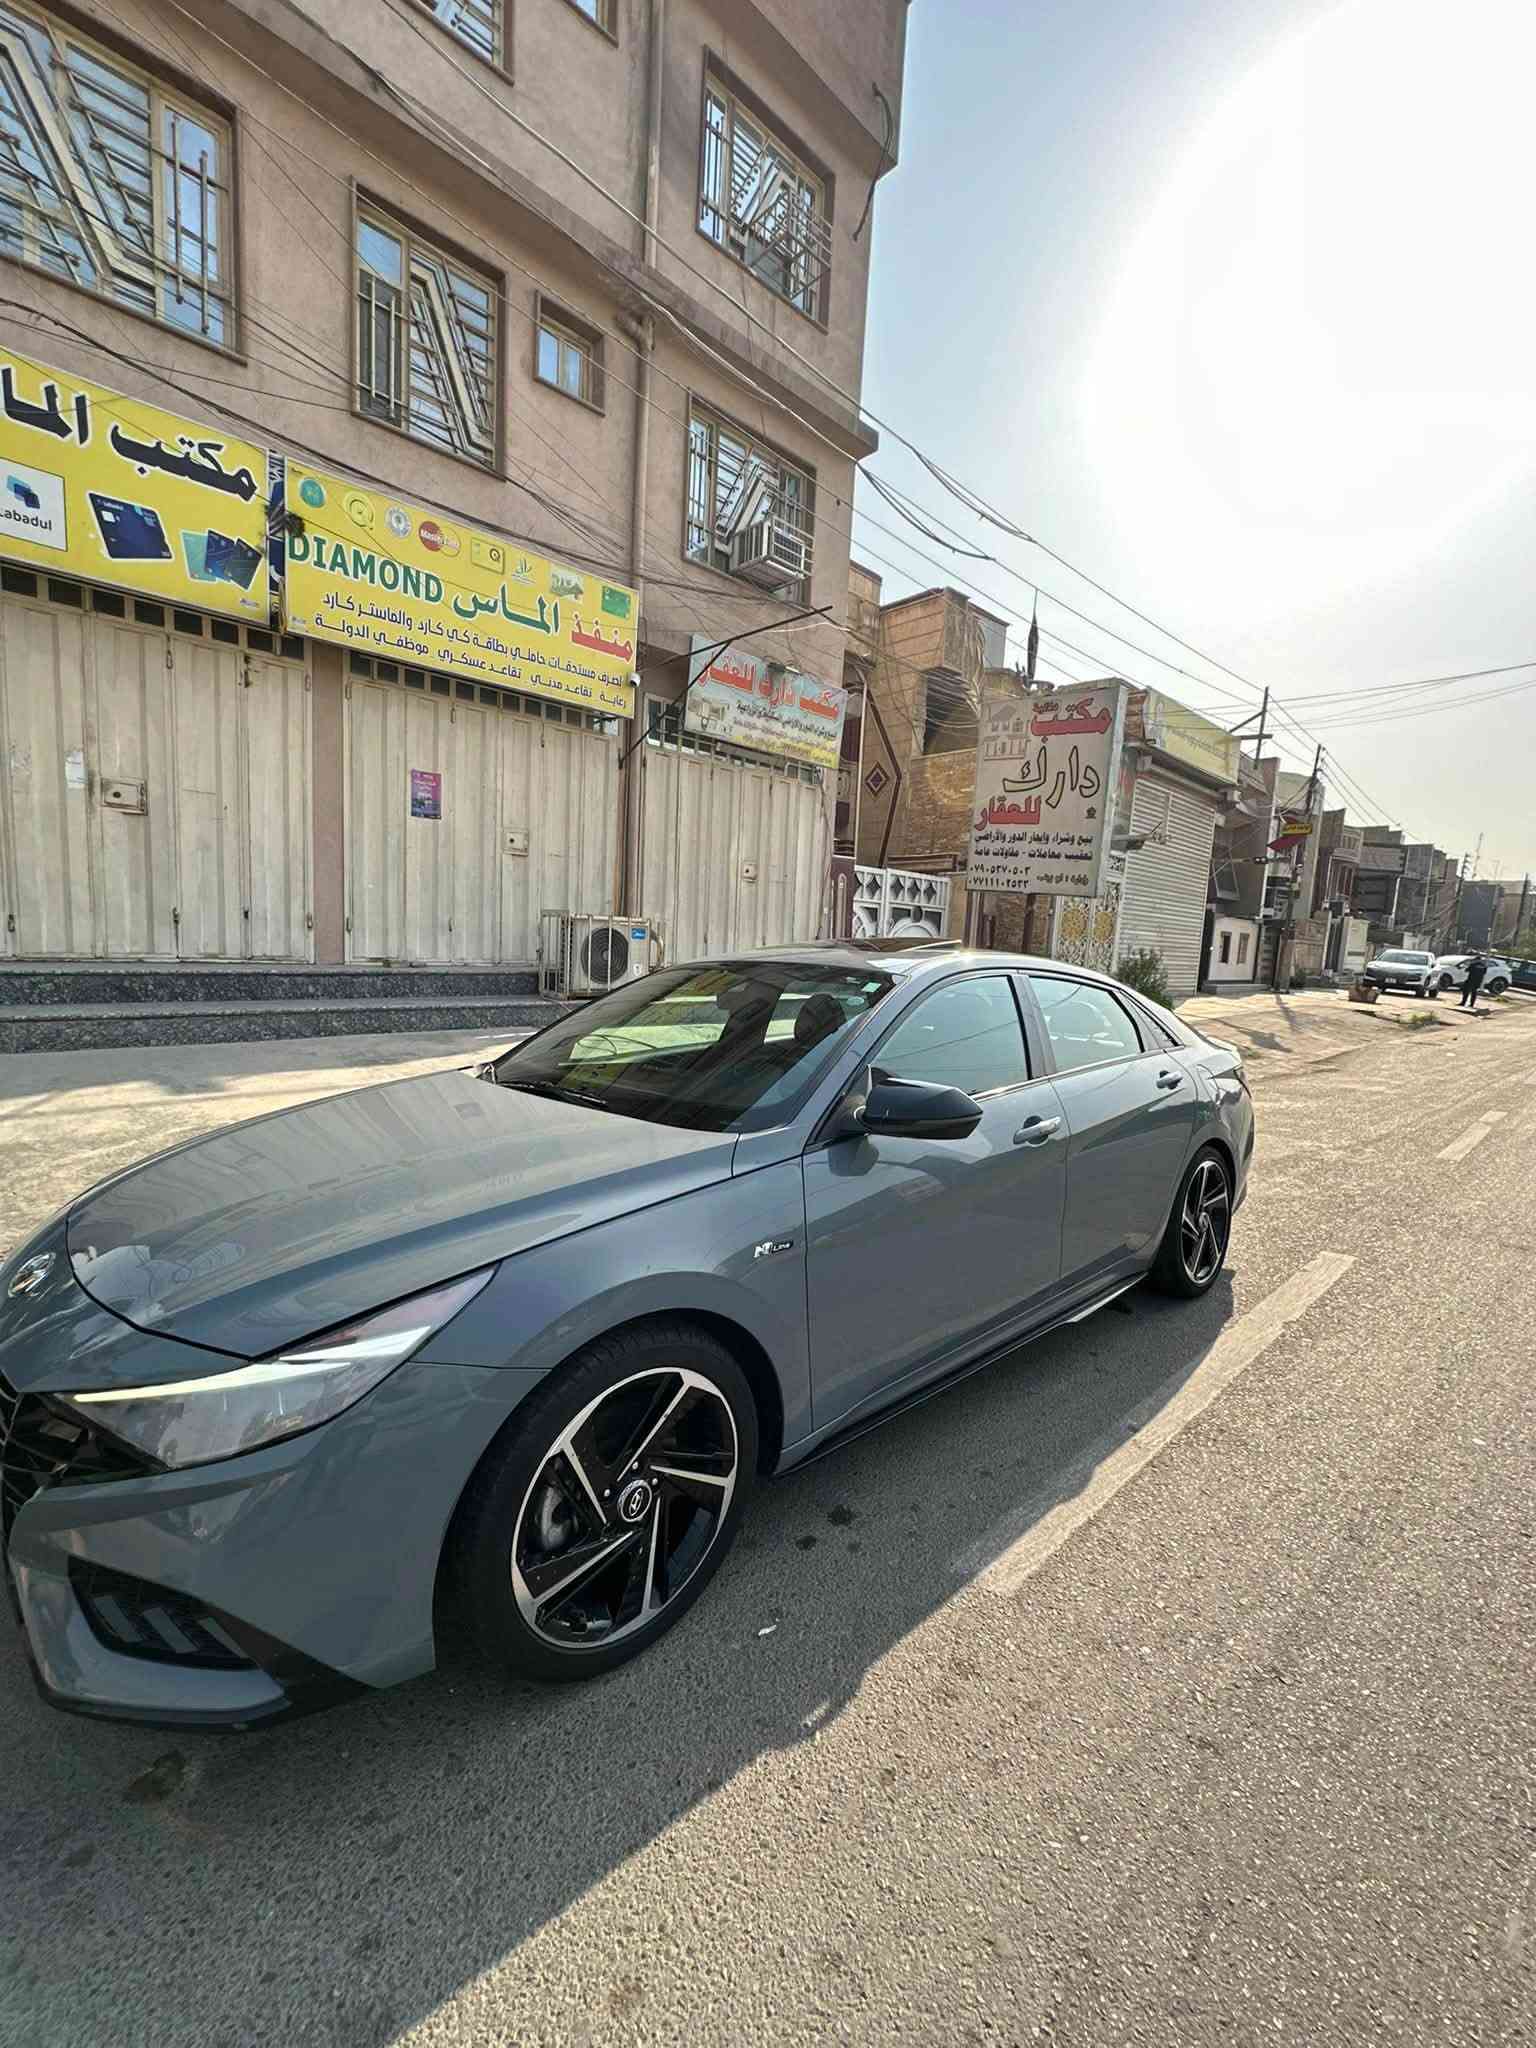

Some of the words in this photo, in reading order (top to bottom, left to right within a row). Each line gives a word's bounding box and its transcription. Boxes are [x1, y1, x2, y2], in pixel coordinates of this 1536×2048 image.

[111, 424, 258, 502] مكتب
[288, 533, 443, 604] DIAMOND
[323, 591, 355, 610] كارد
[452, 583, 560, 634] الماس
[315, 612, 370, 639] الدولة
[358, 601, 413, 631] والماستر
[418, 619, 444, 636] كارد
[373, 630, 429, 655] موظفي
[447, 627, 471, 644] كي
[473, 633, 508, 655] بطاقة
[571, 613, 634, 662] منفذ
[438, 647, 487, 670] عسكري
[511, 647, 545, 666] حاملي
[549, 656, 596, 679] مستحقات
[488, 661, 521, 679] تقاعد
[530, 673, 562, 690] مدني
[566, 682, 592, 698] تقاعد
[1031, 697, 1112, 744] مكتب
[1002, 745, 1100, 809] دارك
[973, 795, 1042, 831] للعقار
